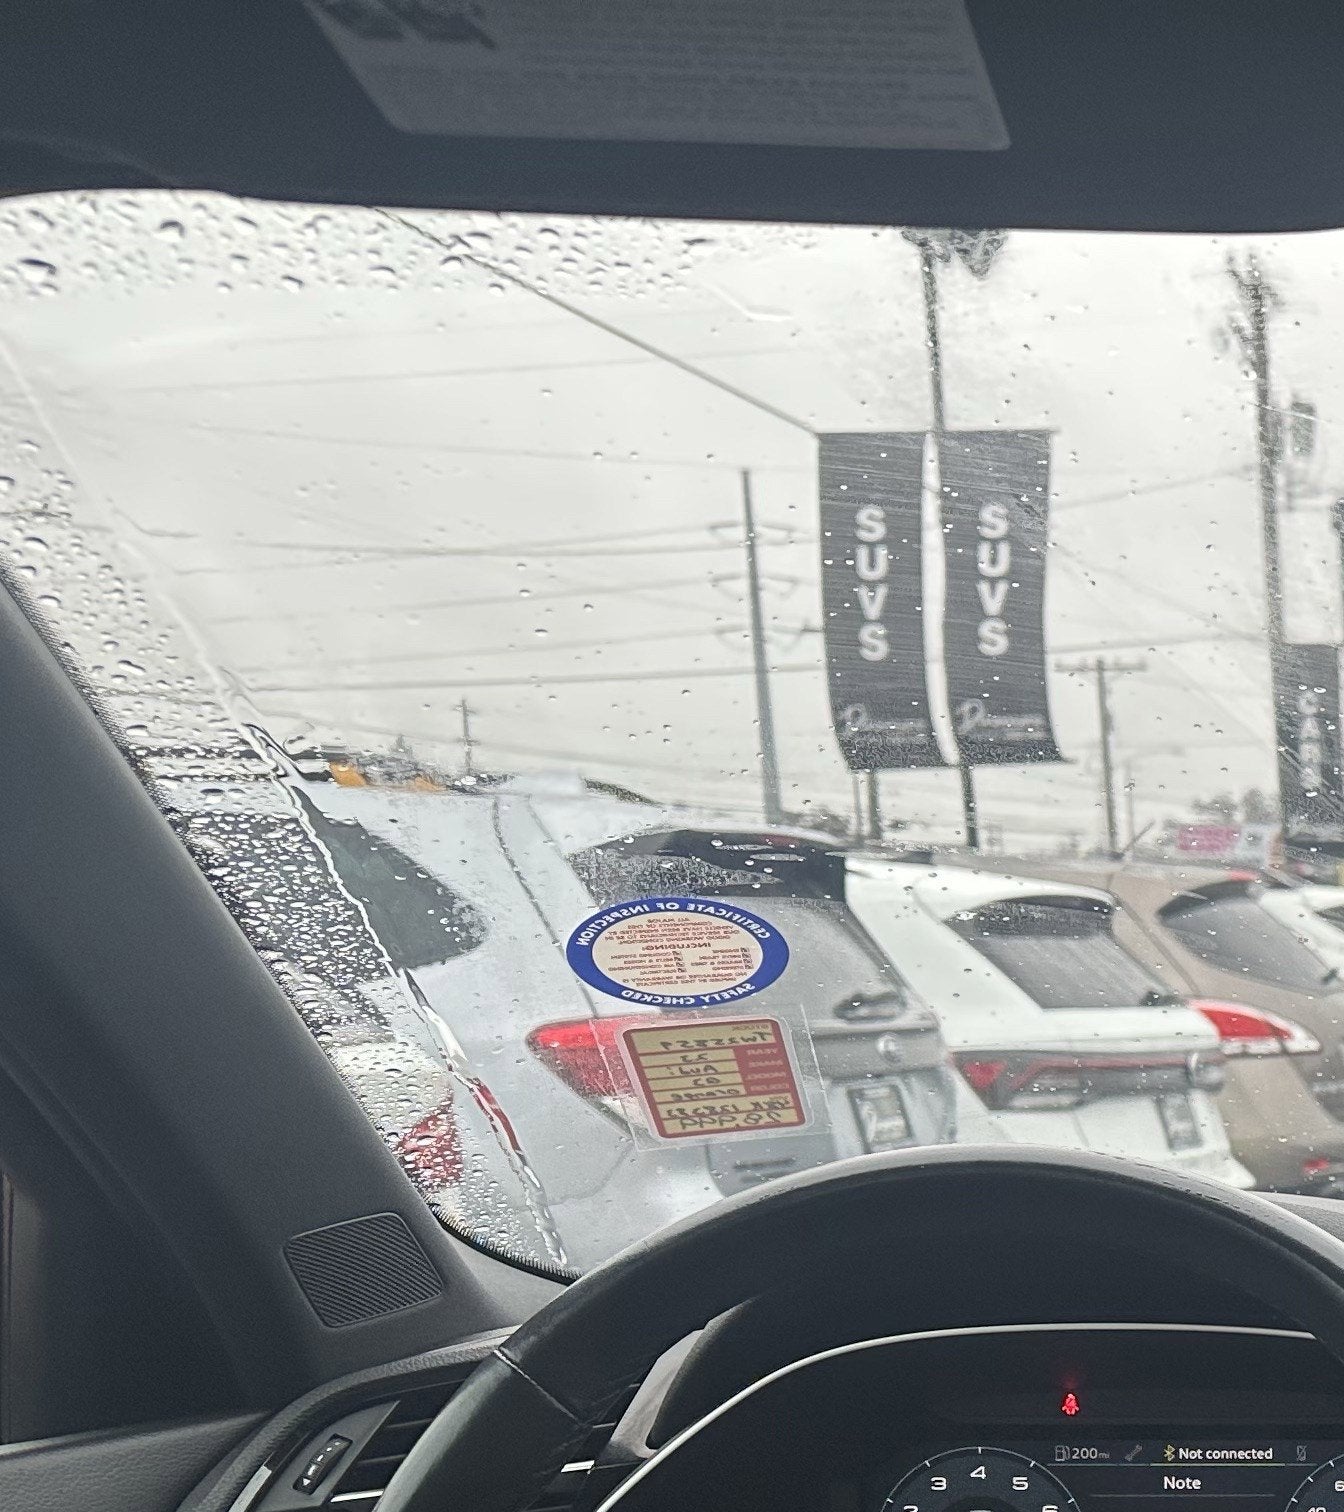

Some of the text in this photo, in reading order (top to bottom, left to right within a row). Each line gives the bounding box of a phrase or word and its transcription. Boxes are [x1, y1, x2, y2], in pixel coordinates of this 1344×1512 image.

[855, 505, 889, 661] SUVS
[978, 502, 1011, 656] SUVS
[1072, 1448, 1098, 1459] 200
[1178, 1448, 1273, 1460] Not connected
[970, 1466, 987, 1480] 4
[931, 1477, 947, 1491] 3
[1012, 1477, 1029, 1491] 5
[1163, 1476, 1201, 1490] Note
